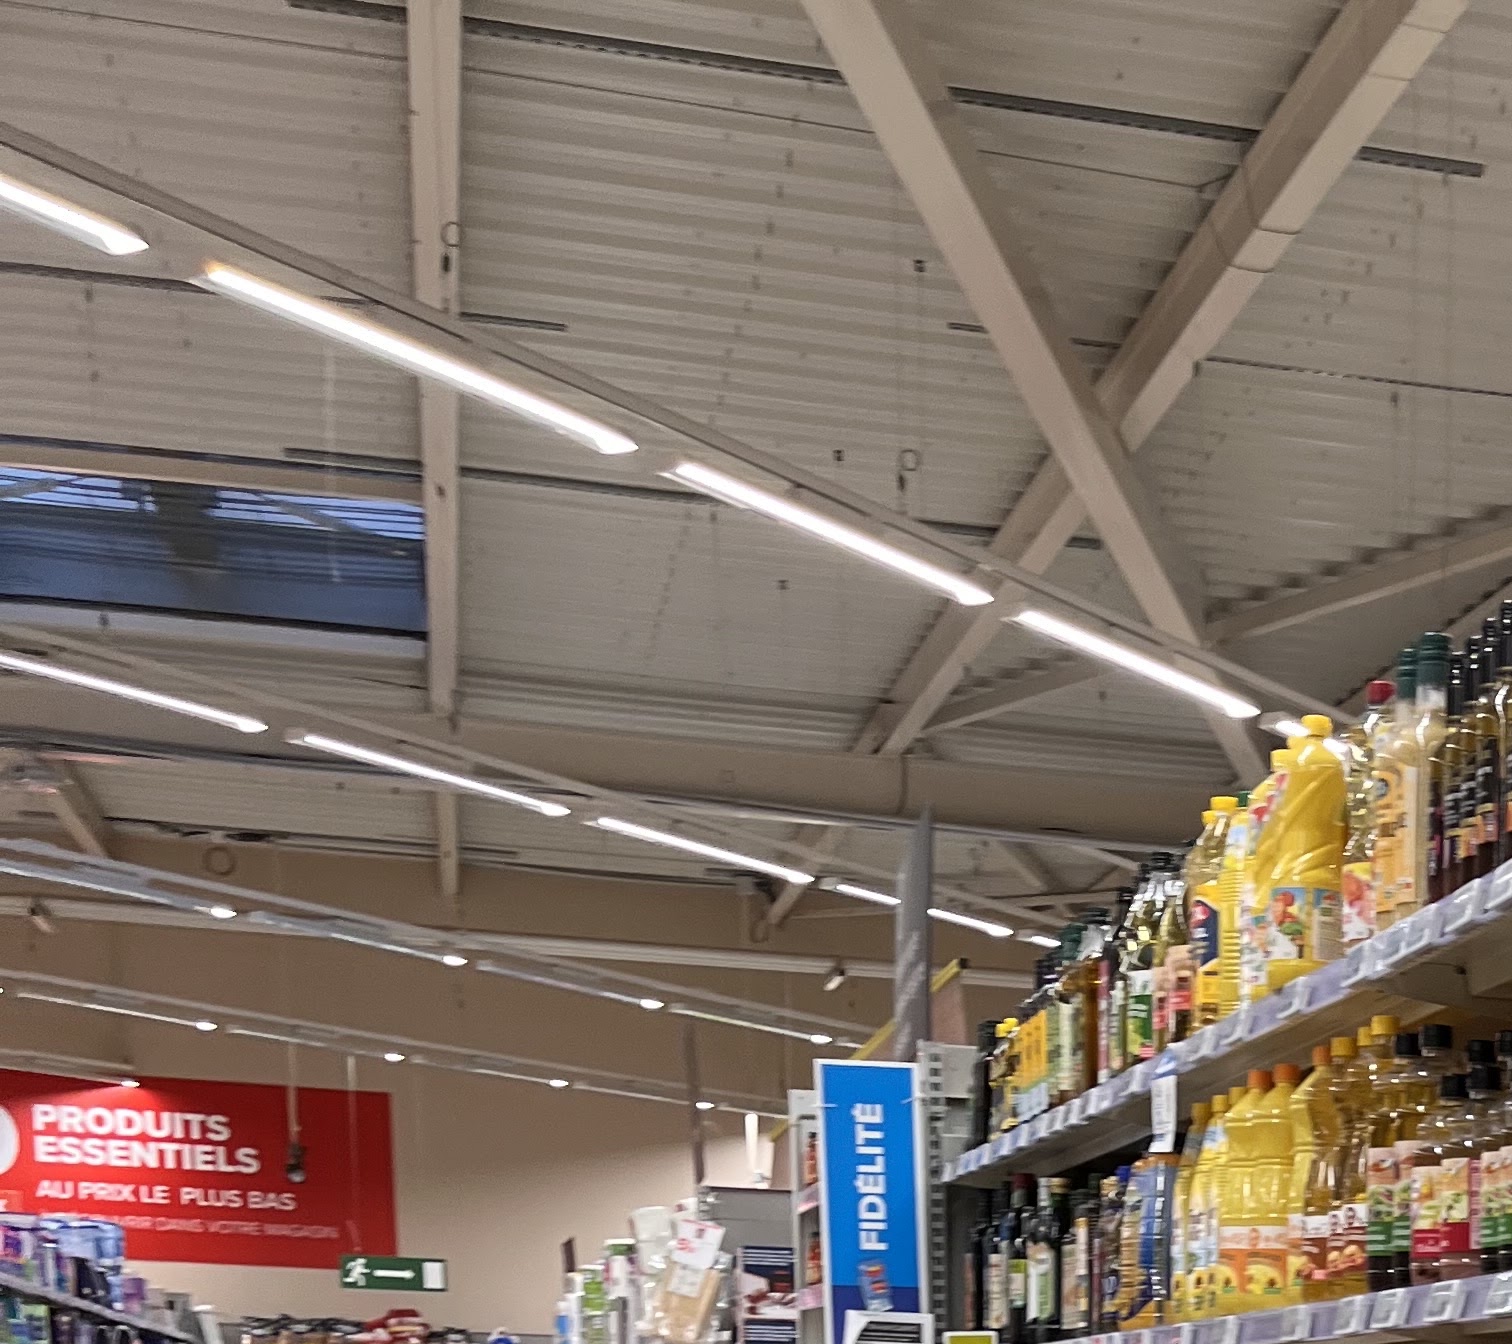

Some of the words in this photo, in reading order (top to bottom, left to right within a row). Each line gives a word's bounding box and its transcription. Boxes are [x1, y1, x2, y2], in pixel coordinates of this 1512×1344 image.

[32, 1103, 232, 1143] PRODUITS
[33, 1136, 263, 1175] ESSENTIELS
[35, 1179, 74, 1200] AU
[78, 1181, 136, 1203] PRIX
[139, 1184, 170, 1205] LE
[180, 1187, 244, 1208] PLUS
[247, 1191, 297, 1211] BAS
[852, 1101, 888, 1252] FIDÉLITÉ
